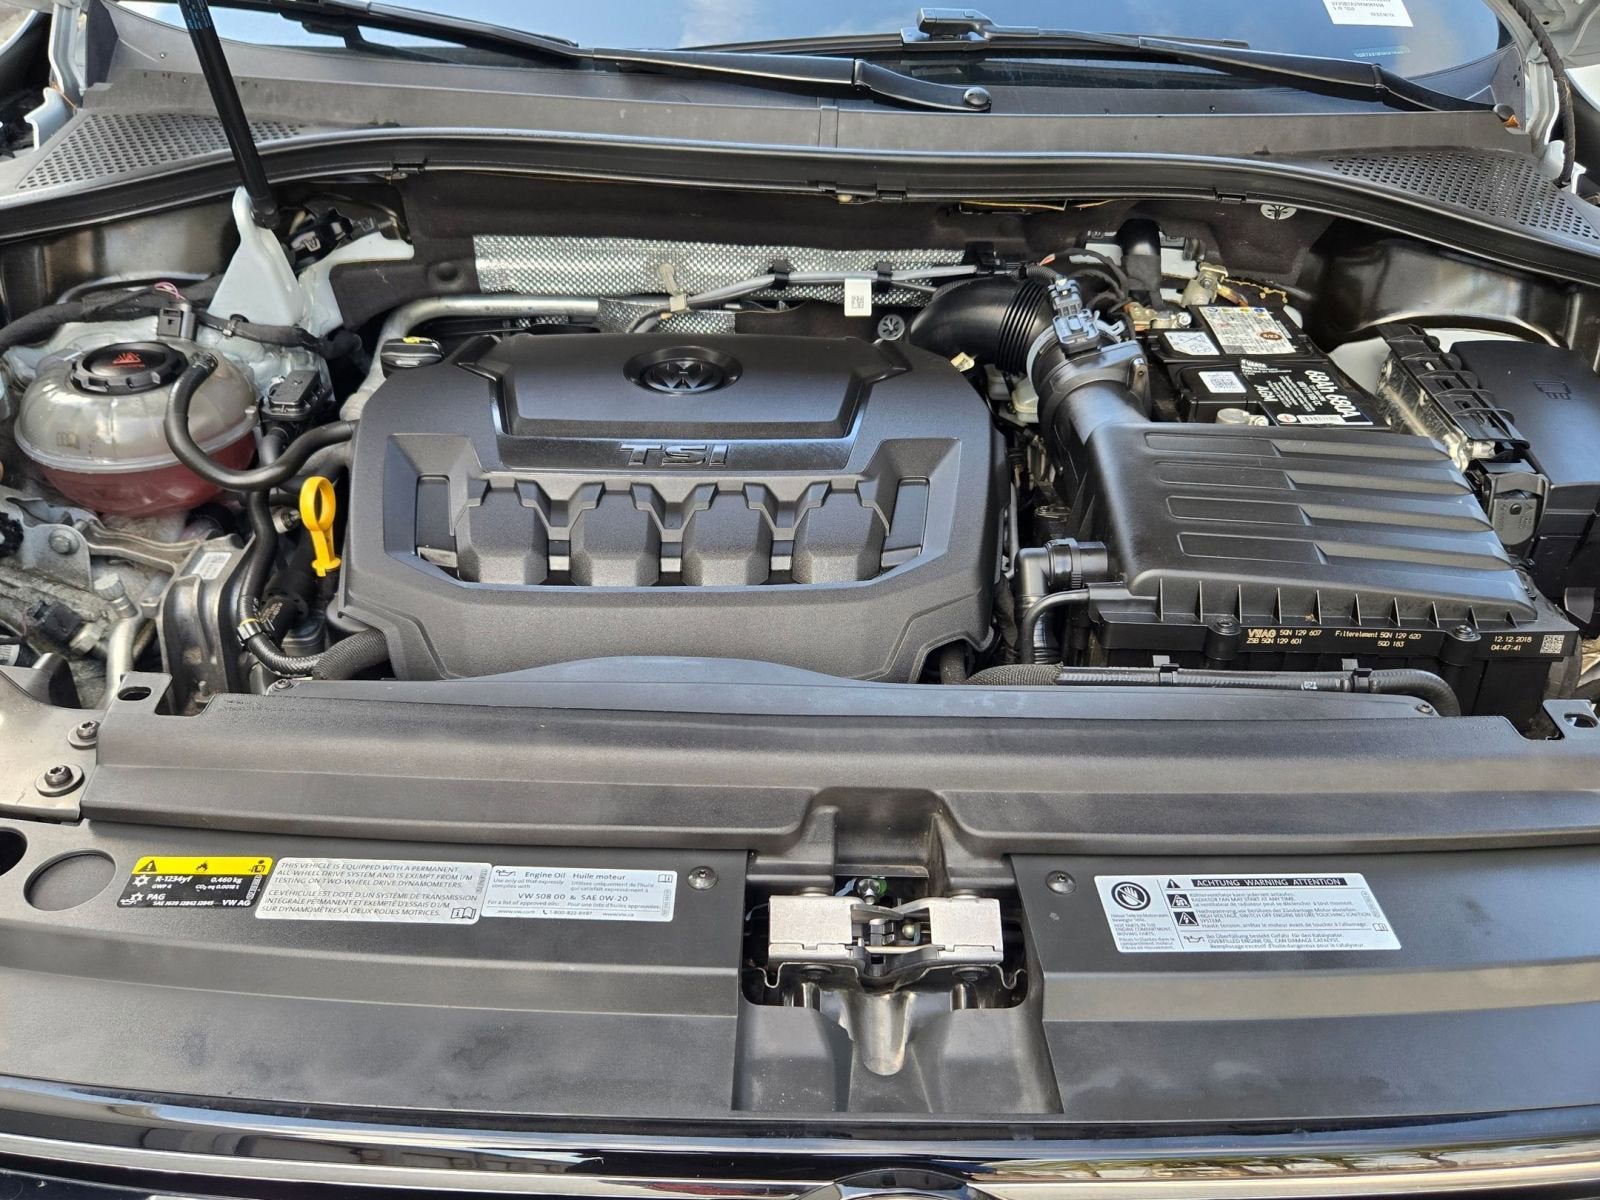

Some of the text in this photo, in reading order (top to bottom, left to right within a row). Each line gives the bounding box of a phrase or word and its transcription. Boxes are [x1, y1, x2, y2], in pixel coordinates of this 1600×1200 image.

[1304, 370, 1338, 393] 68Ah
[1325, 394, 1361, 418] 680A
[620, 443, 730, 467] TSI
[1308, 629, 1323, 637] 607
[342, 863, 380, 871] EQUIPPED
[154, 875, 194, 884] R-1234yf
[525, 871, 554, 880] Engine
[1197, 879, 1342, 887] ACHTUNG WARNING ATTENTION
[422, 893, 478, 901] TRANSMISSION
